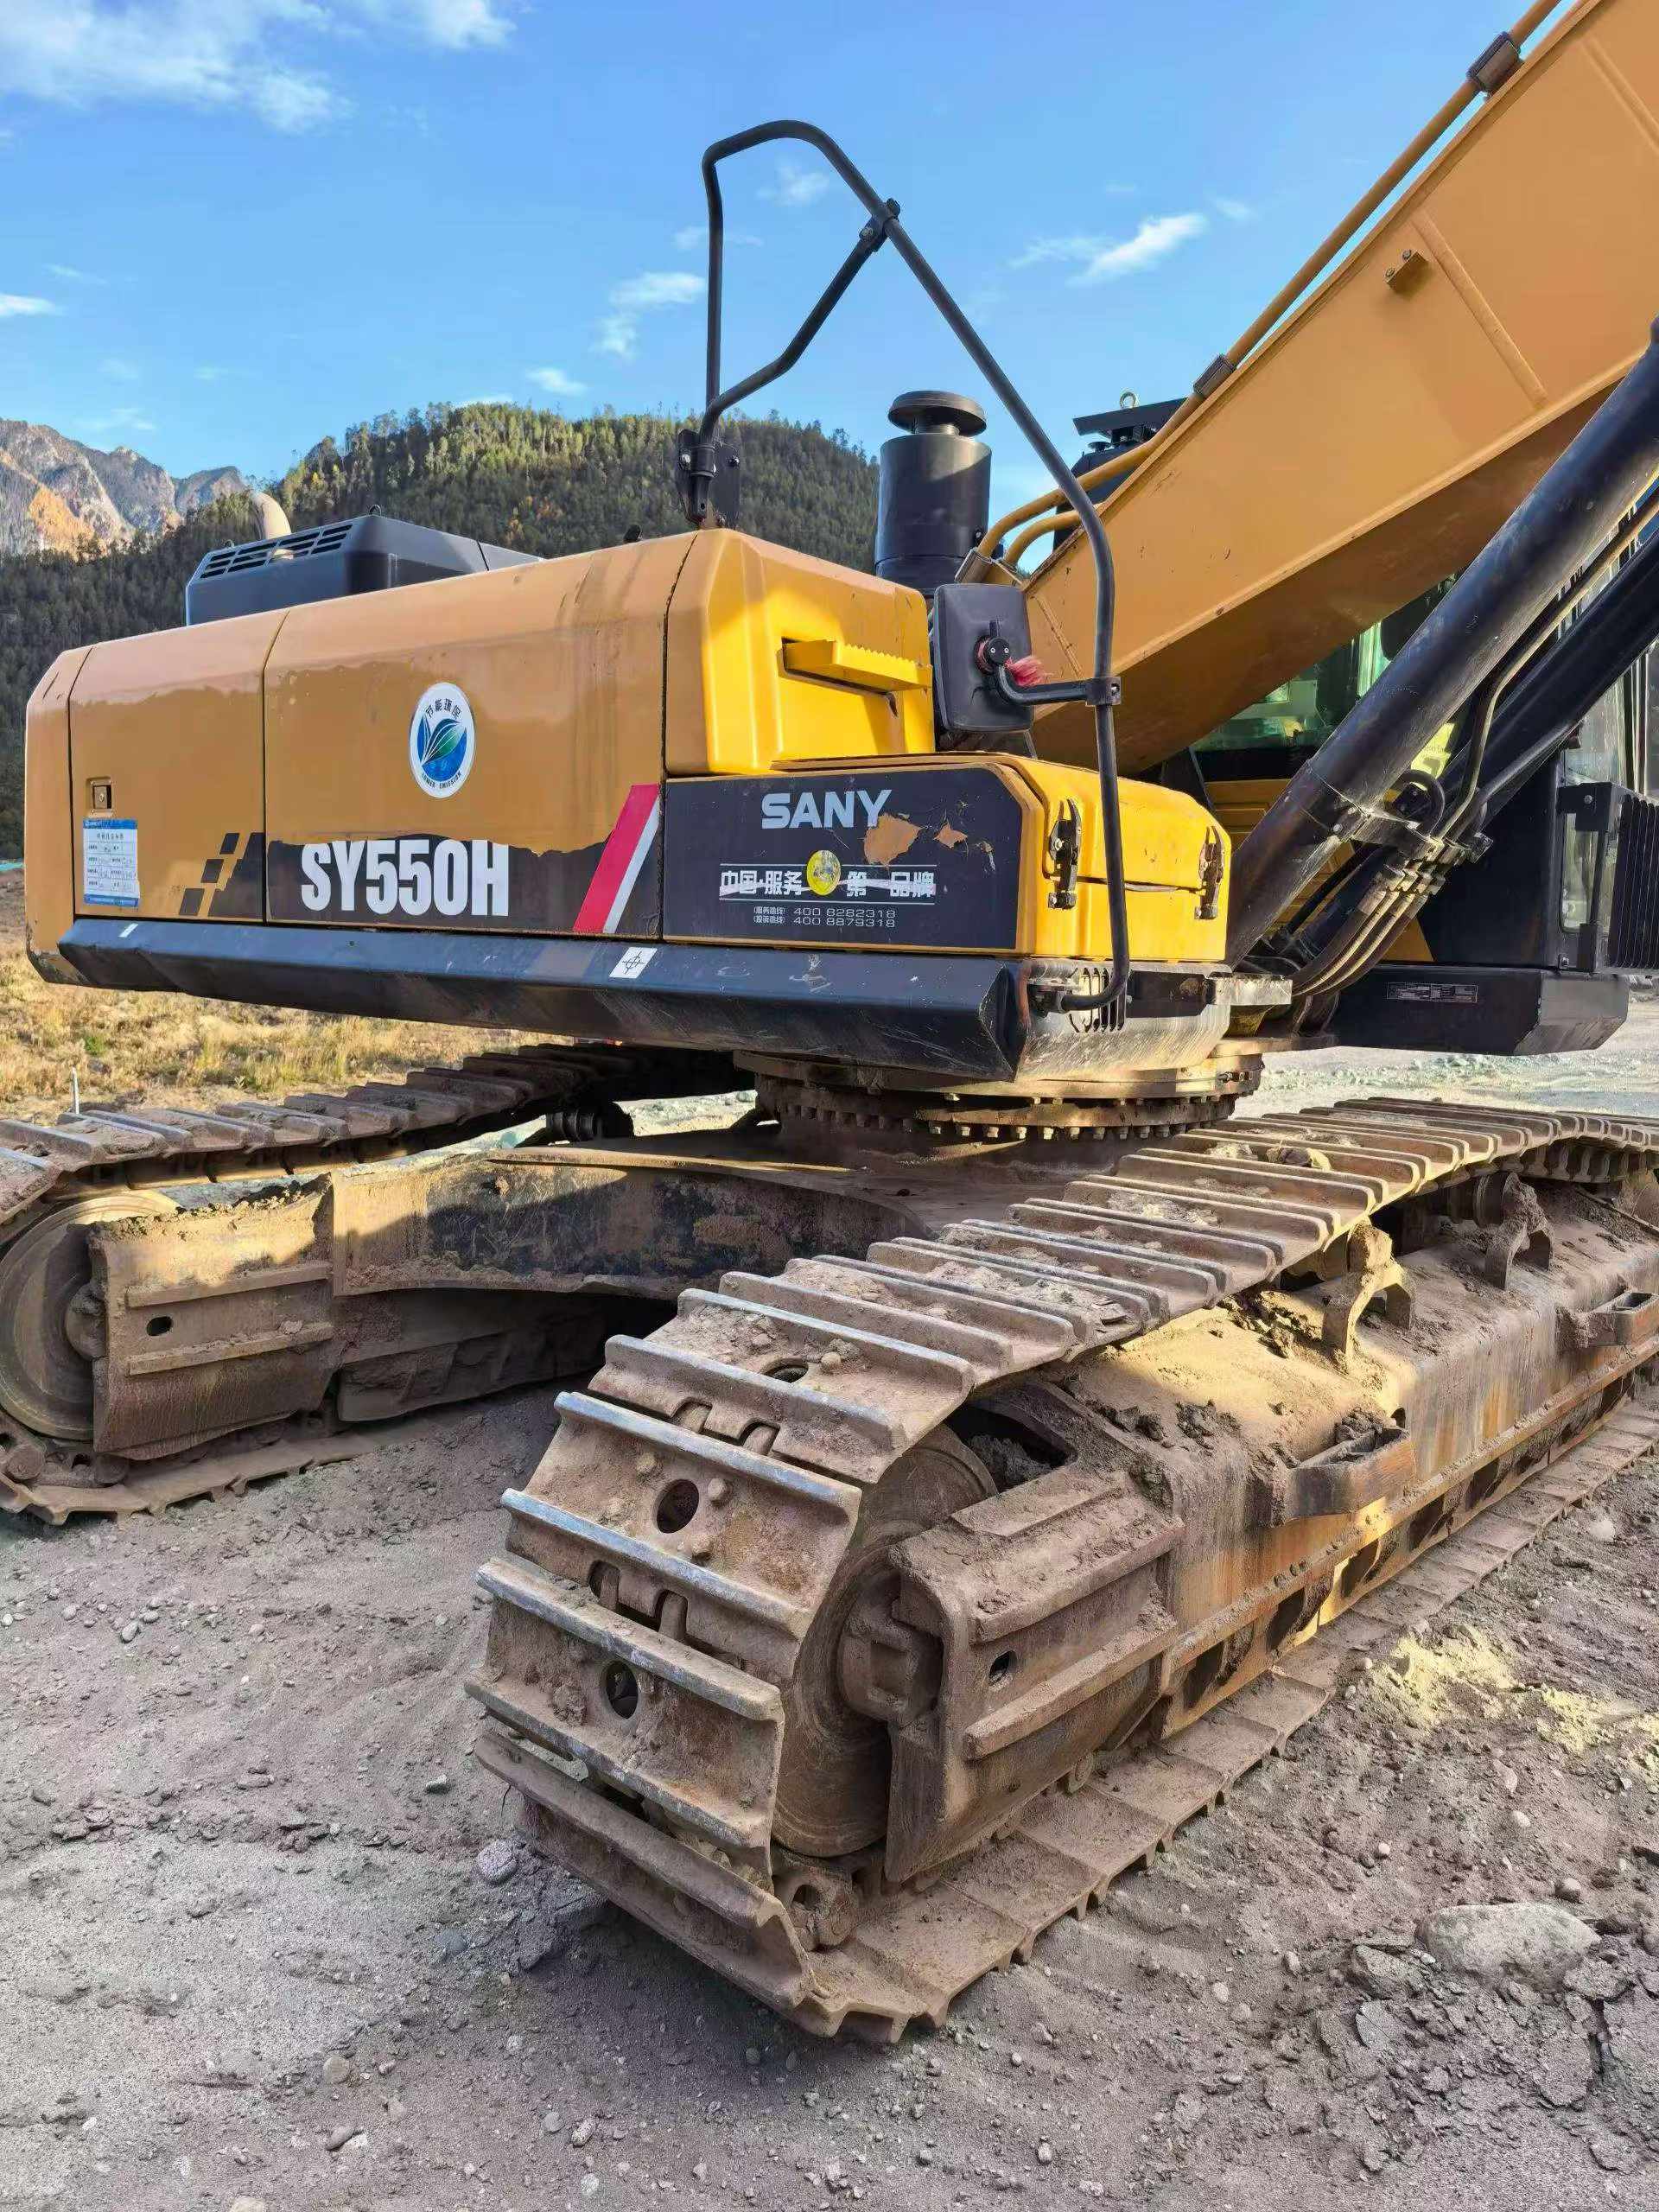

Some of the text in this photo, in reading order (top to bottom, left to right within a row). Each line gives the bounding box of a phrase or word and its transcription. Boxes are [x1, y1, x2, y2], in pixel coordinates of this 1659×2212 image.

[761, 789, 892, 830] SANY
[301, 839, 509, 917] SY550H
[793, 907, 821, 916] 400
[826, 908, 896, 918] 8282318
[793, 917, 821, 926] 400
[826, 917, 896, 928] 8879318
